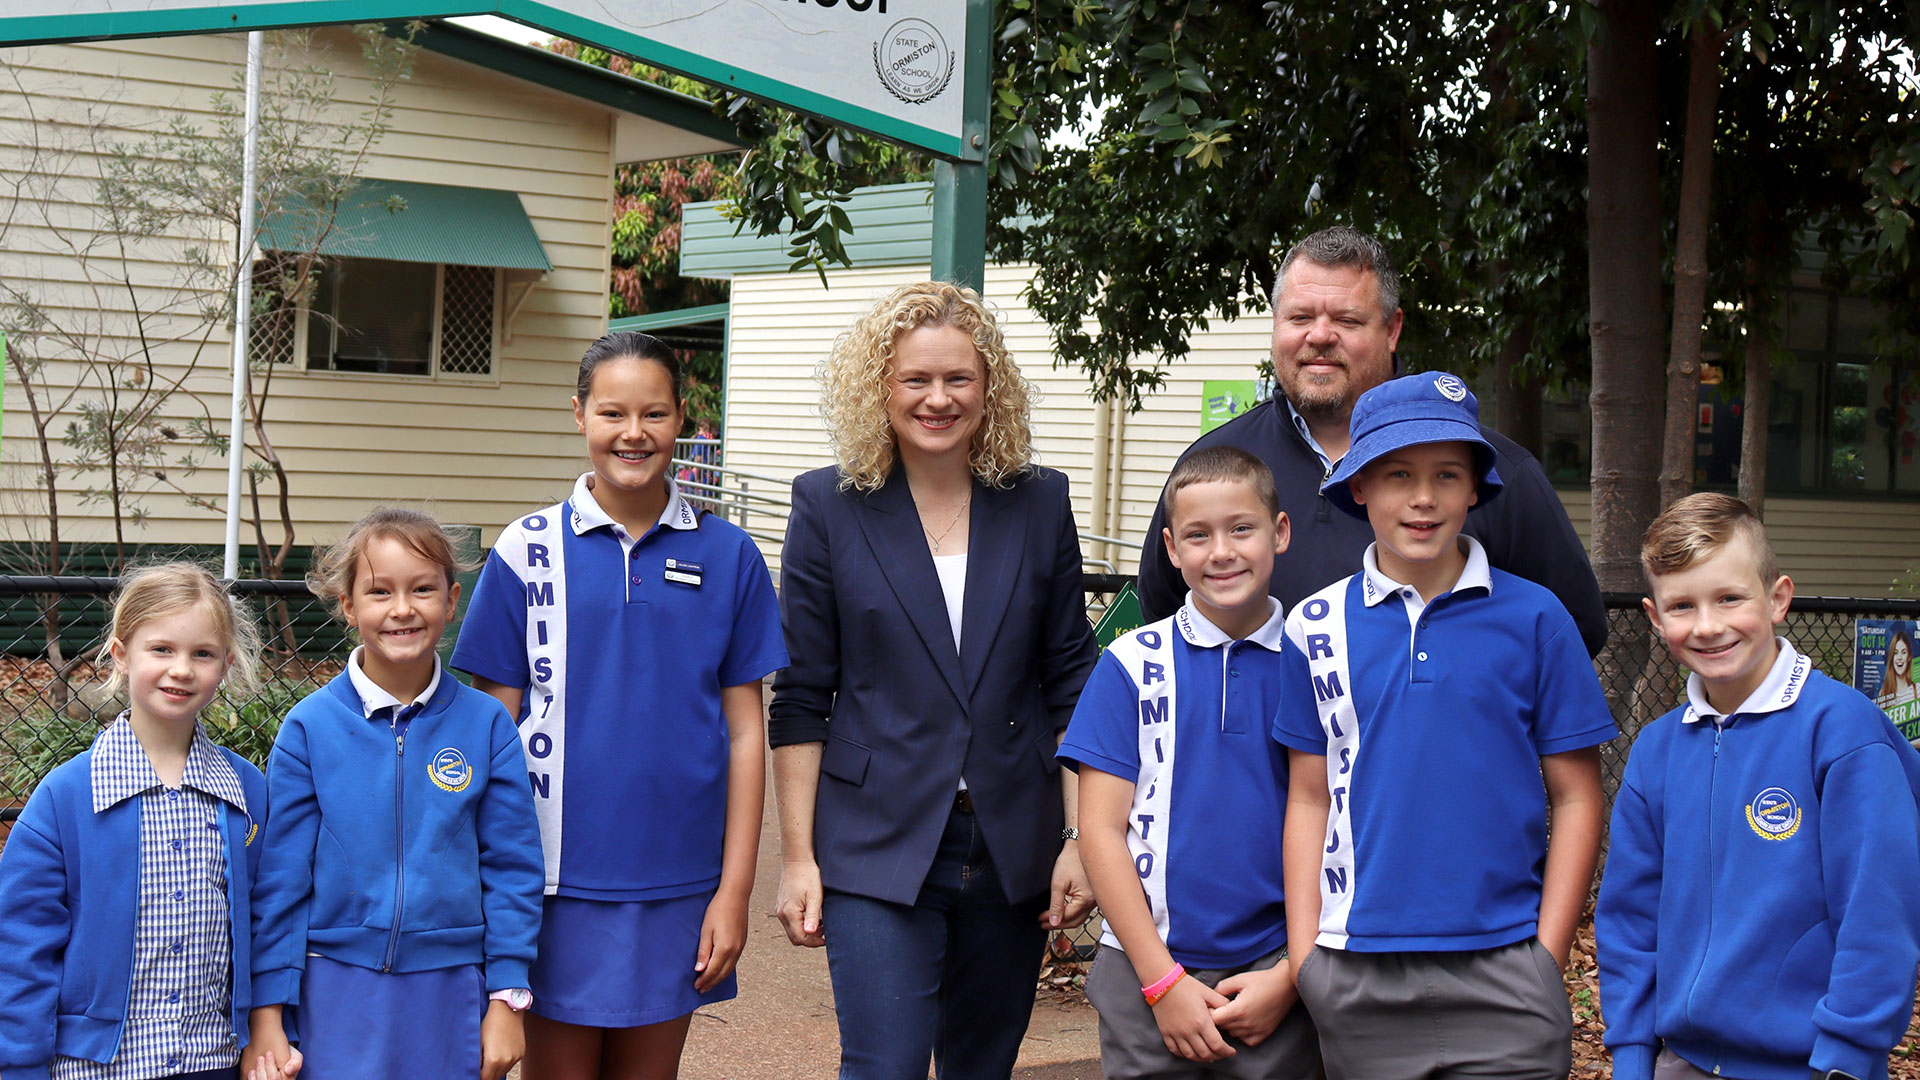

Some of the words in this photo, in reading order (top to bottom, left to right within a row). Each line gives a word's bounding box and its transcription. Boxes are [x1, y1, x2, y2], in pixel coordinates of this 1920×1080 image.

[895, 37, 919, 48] STATE
[892, 41, 936, 71] ORMISTON
[885, 68, 901, 88] LEARN
[924, 76, 940, 91] GROW
[901, 67, 932, 79] SCHOOL
[1862, 626, 1886, 634] SATURDAY
[1862, 636, 1876, 648] OCT
[1878, 636, 1886, 649] 14
[522, 515, 554, 799] ORMISTON
[1136, 630, 1169, 918] ORMITO
